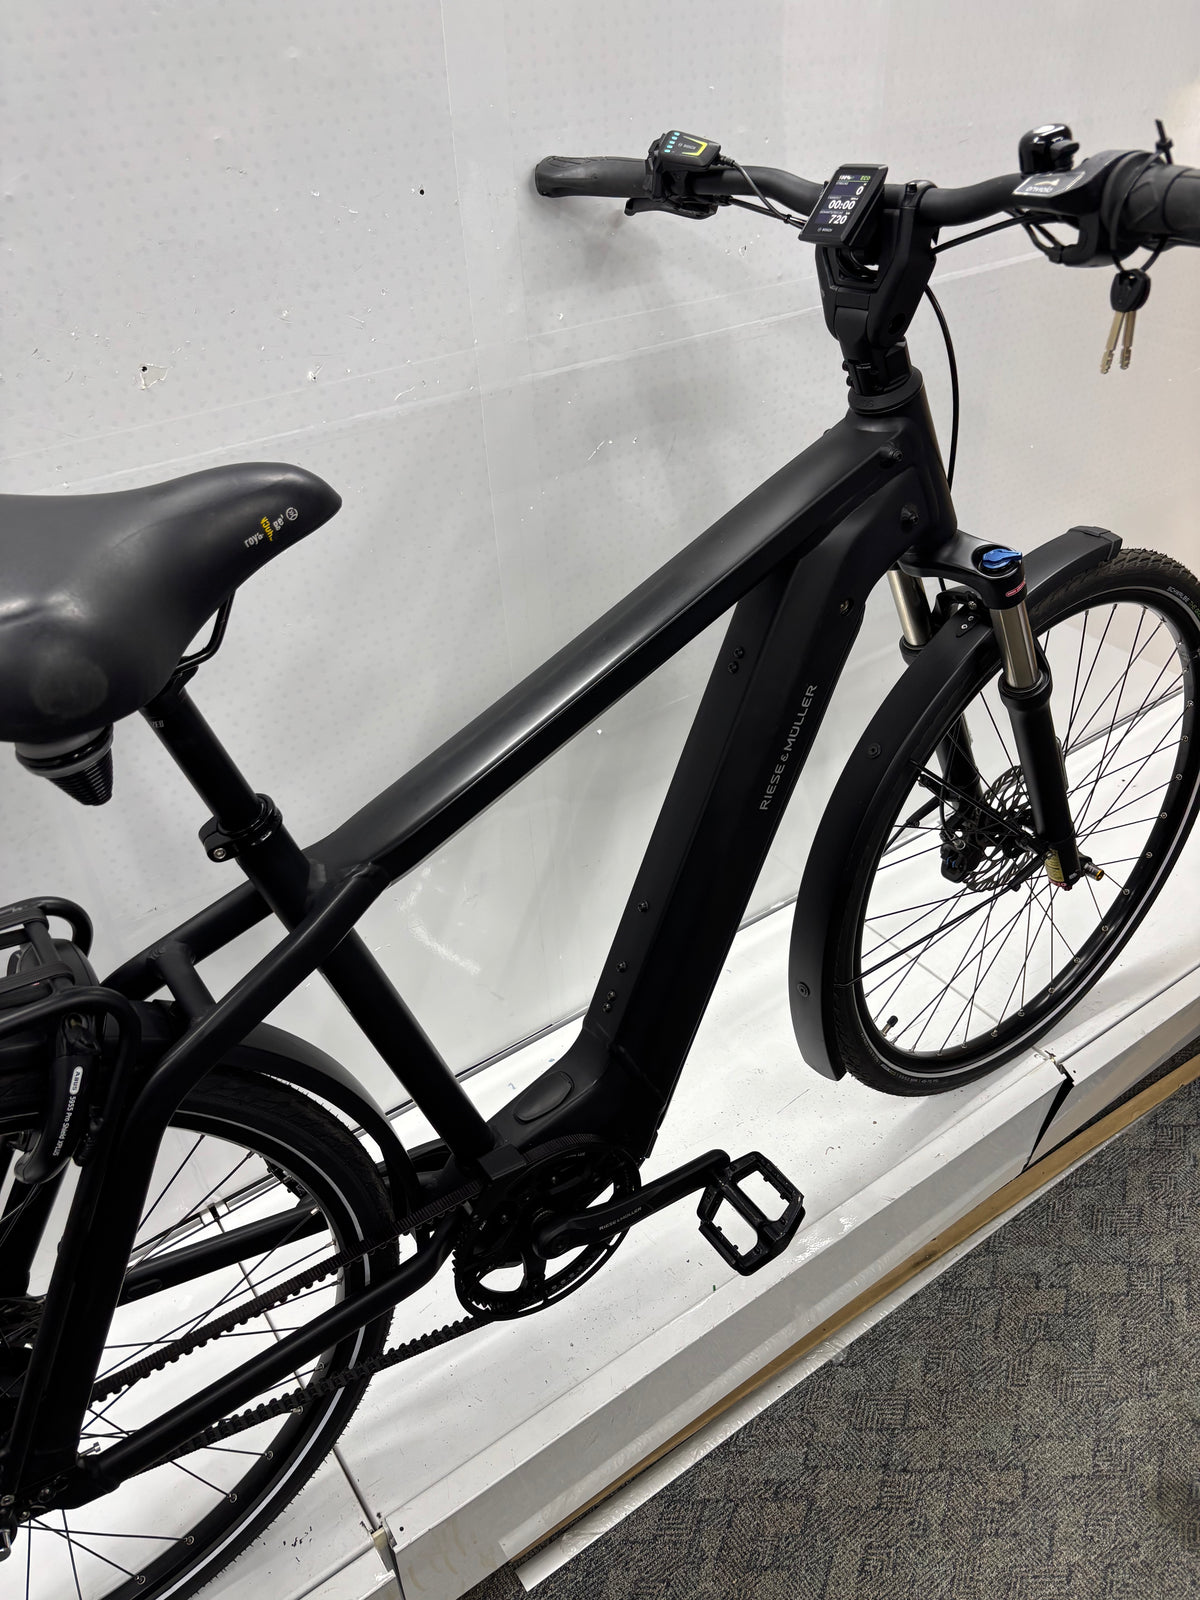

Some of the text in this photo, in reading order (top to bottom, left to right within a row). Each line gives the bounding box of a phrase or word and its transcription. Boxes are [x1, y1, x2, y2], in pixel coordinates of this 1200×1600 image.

[855, 186, 864, 196] 0
[828, 199, 856, 210] 00:00
[828, 214, 848, 224] 720
[759, 685, 818, 810] RIESE & MÜLLER
[72, 1071, 80, 1091] ABUS
[67, 1095, 77, 1111] 5955
[64, 1112, 72, 1122] Pro
